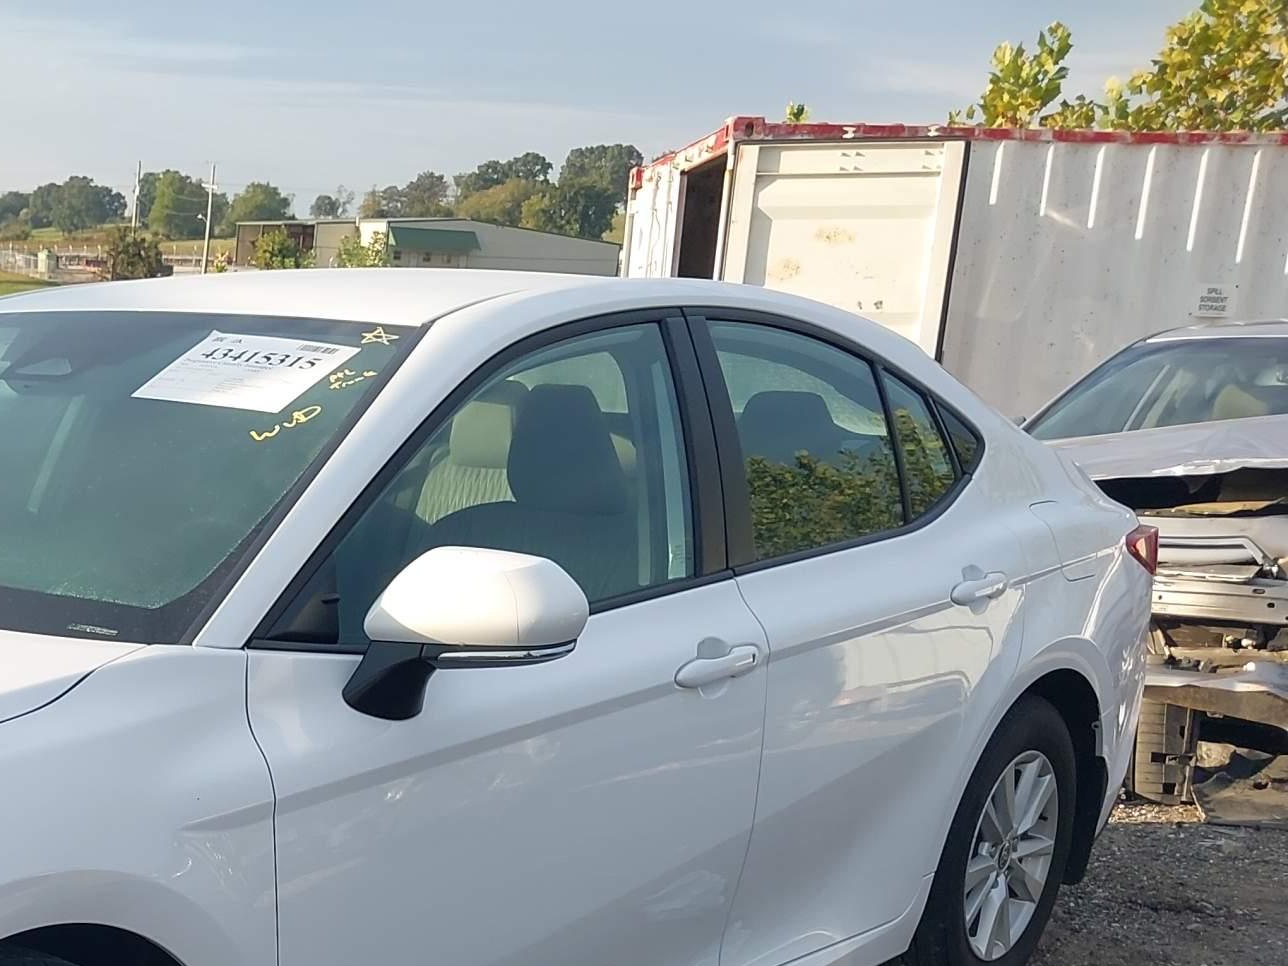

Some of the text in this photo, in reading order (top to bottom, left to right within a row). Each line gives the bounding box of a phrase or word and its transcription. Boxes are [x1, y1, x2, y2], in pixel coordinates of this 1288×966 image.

[1207, 287, 1222, 295] SPILL
[1198, 304, 1227, 312] STORAGE
[201, 347, 323, 370] 43415315
